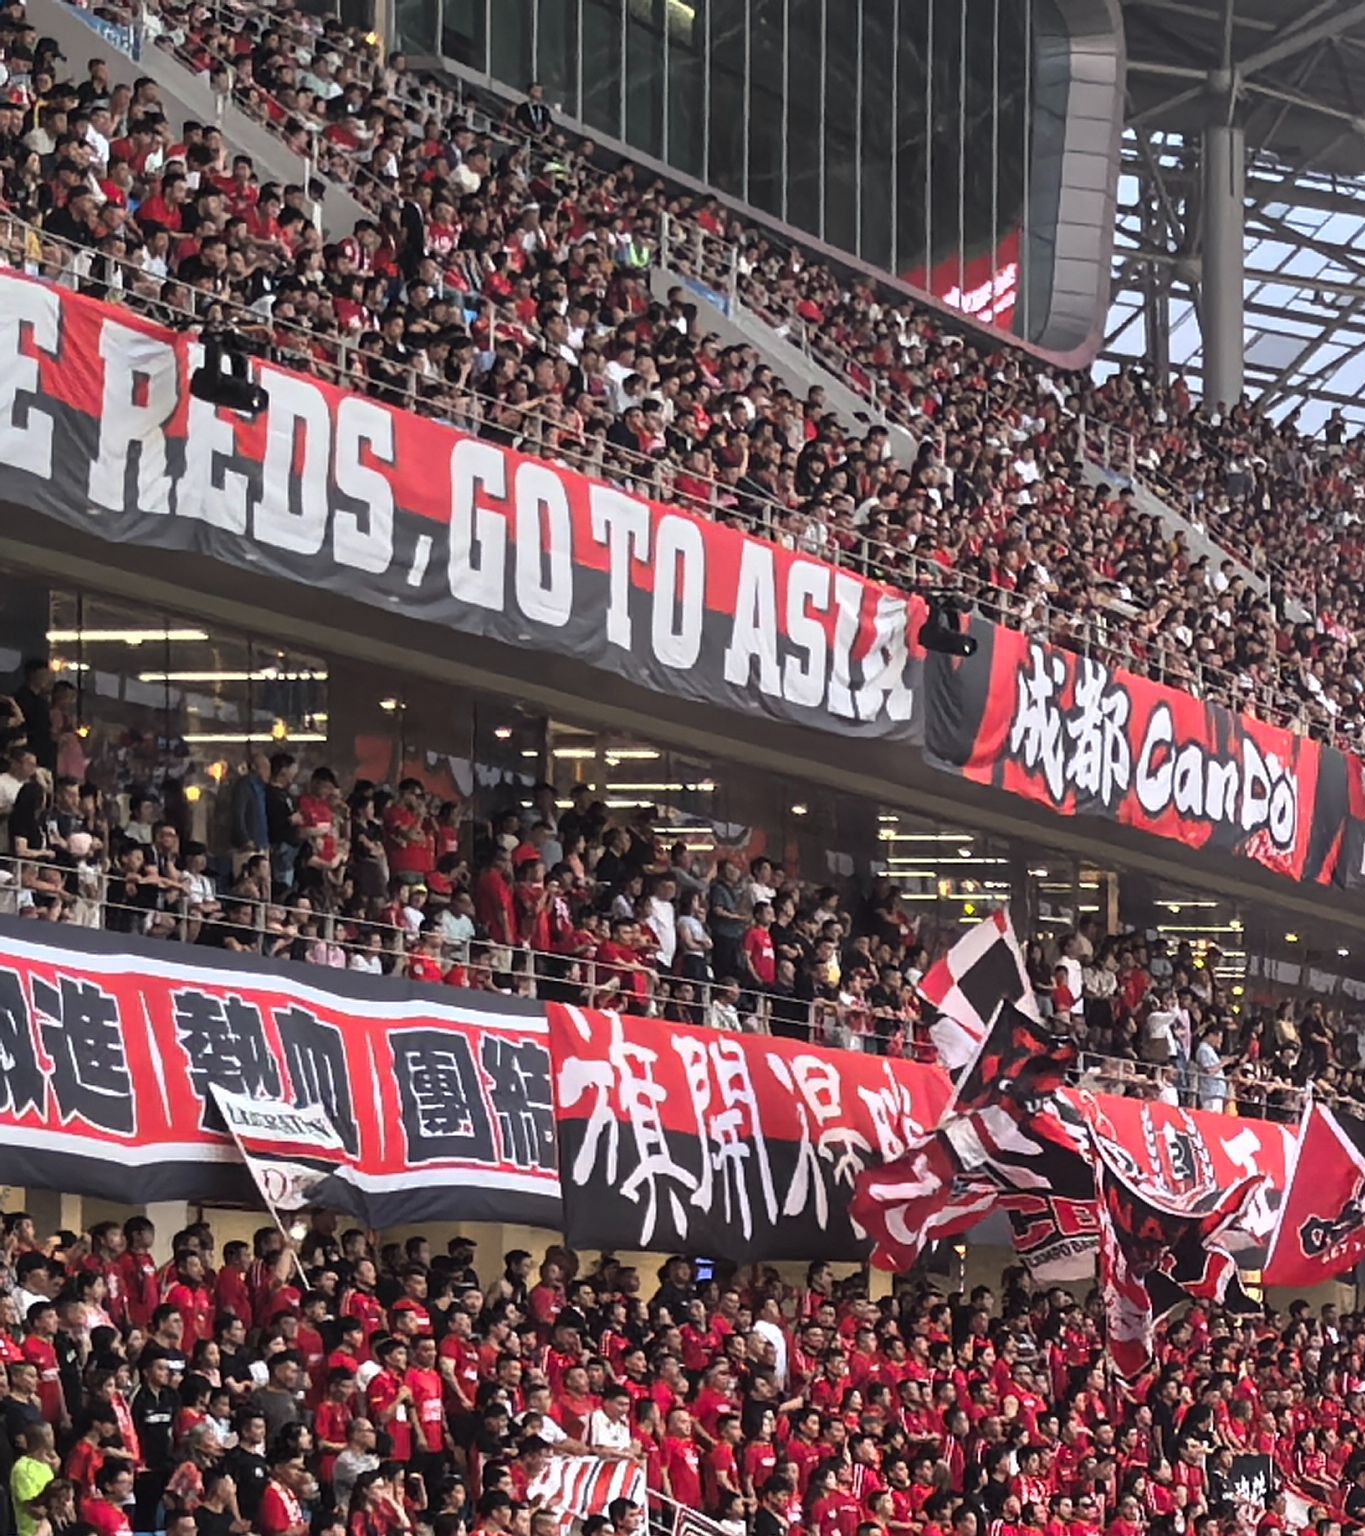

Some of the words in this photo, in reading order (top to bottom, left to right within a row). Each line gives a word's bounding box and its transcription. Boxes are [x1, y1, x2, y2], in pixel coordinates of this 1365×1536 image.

[449, 439, 574, 627] GO
[589, 484, 706, 669] TO
[724, 538, 913, 722] ASIA
[1011, 644, 1130, 807] 成都
